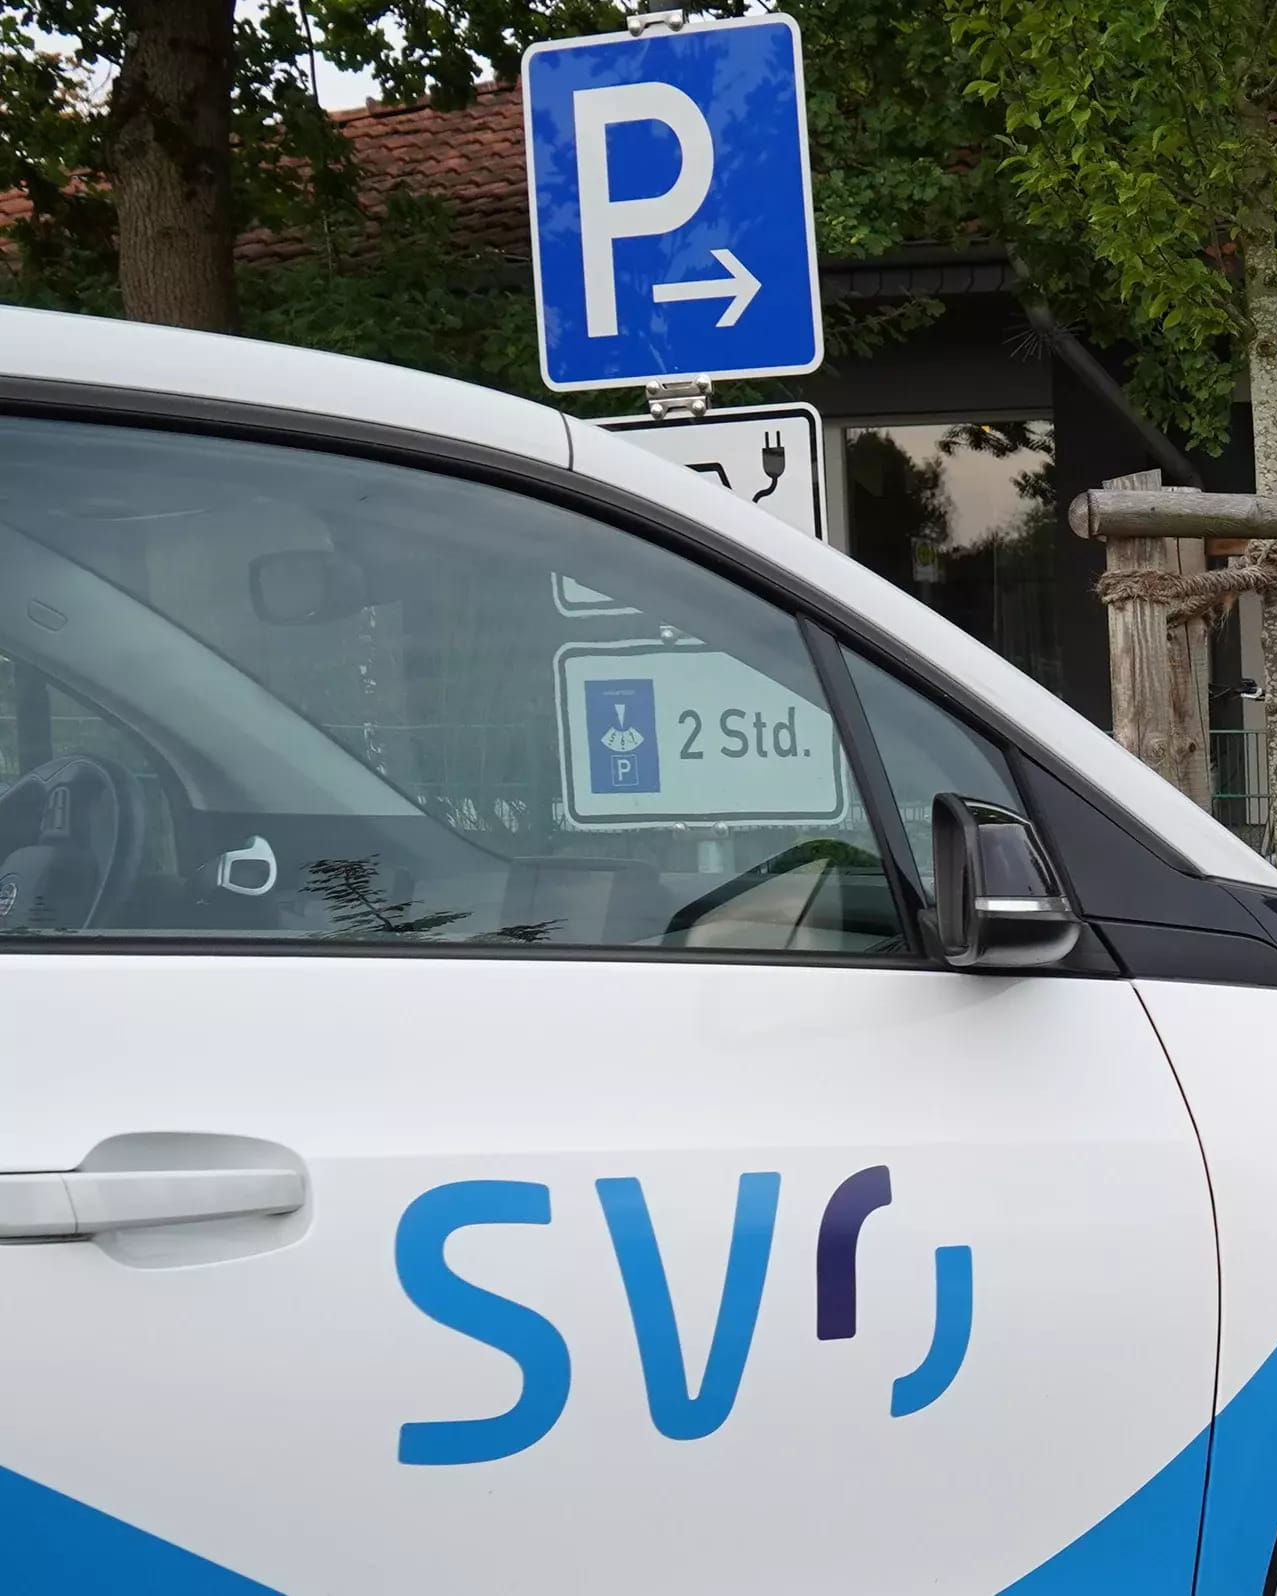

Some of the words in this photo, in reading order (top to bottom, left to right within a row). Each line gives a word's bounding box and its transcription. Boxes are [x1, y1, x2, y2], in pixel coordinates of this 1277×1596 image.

[573, 82, 714, 338] P
[678, 709, 704, 760] 2
[719, 706, 811, 758] Std.
[617, 759, 631, 781] P
